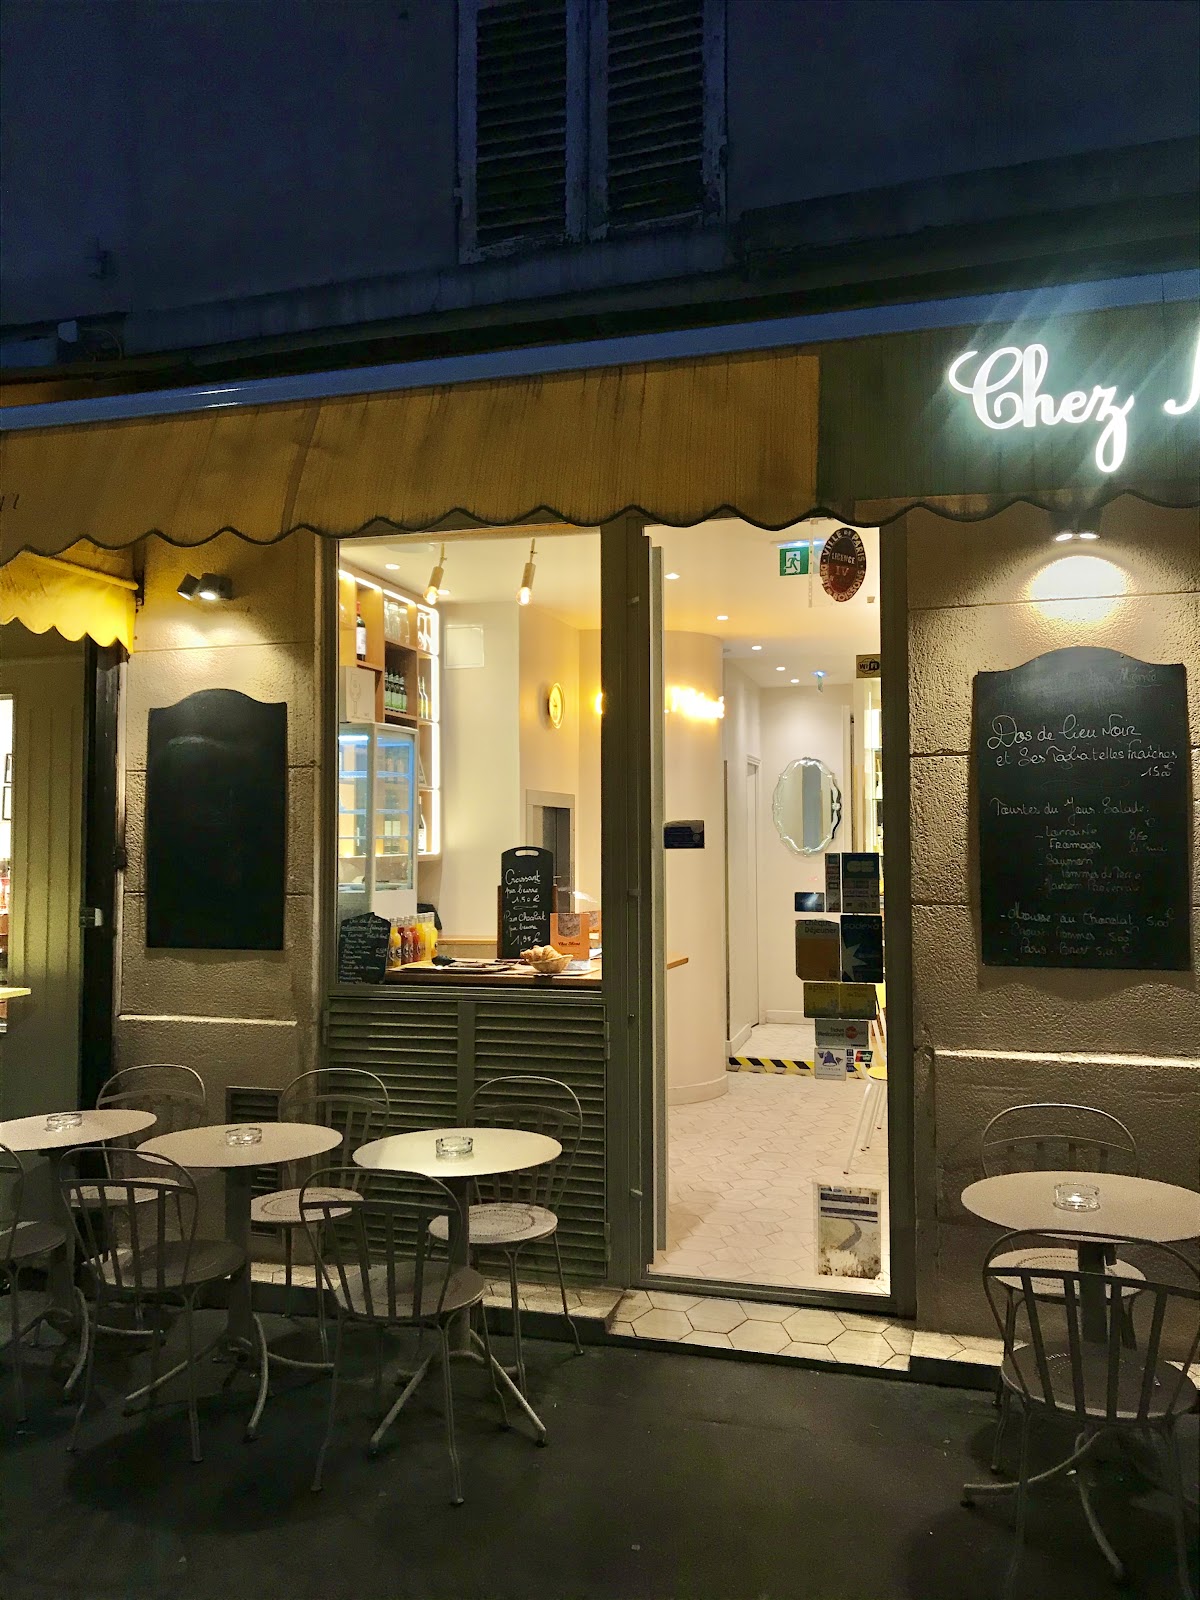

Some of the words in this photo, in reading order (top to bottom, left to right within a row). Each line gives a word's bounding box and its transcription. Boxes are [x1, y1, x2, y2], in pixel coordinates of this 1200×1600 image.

[948, 343, 1135, 473] Chez
[823, 530, 843, 556] VILLE
[852, 534, 865, 562] PARIS
[831, 553, 856, 565] LICENCE
[836, 565, 849, 577] IV
[832, 570, 866, 601] BOISSONS
[987, 714, 1032, 749] Dos
[1037, 726, 1056, 741] de
[996, 751, 1014, 767] et
[1044, 802, 1059, 814] du
[505, 868, 541, 885] Croissant
[1060, 914, 1077, 924] au
[1083, 907, 1133, 925] Chocolat
[804, 926, 837, 934] Déjeuner
